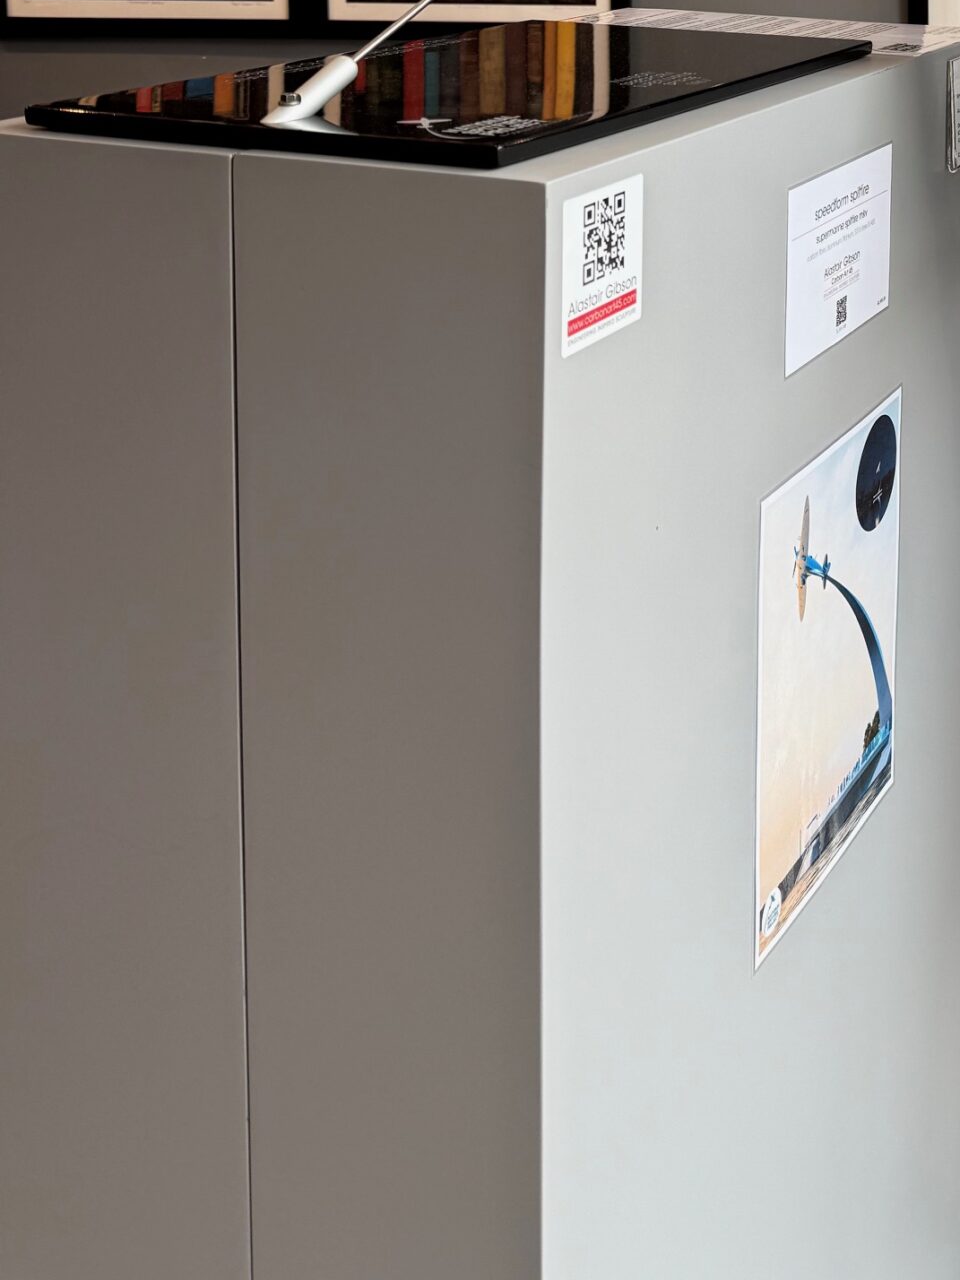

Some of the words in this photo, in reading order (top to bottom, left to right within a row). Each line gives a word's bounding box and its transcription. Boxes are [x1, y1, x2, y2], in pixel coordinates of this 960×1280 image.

[814, 194, 849, 222] speedform
[568, 291, 603, 317] Alastair
[606, 276, 637, 298] Gibson
